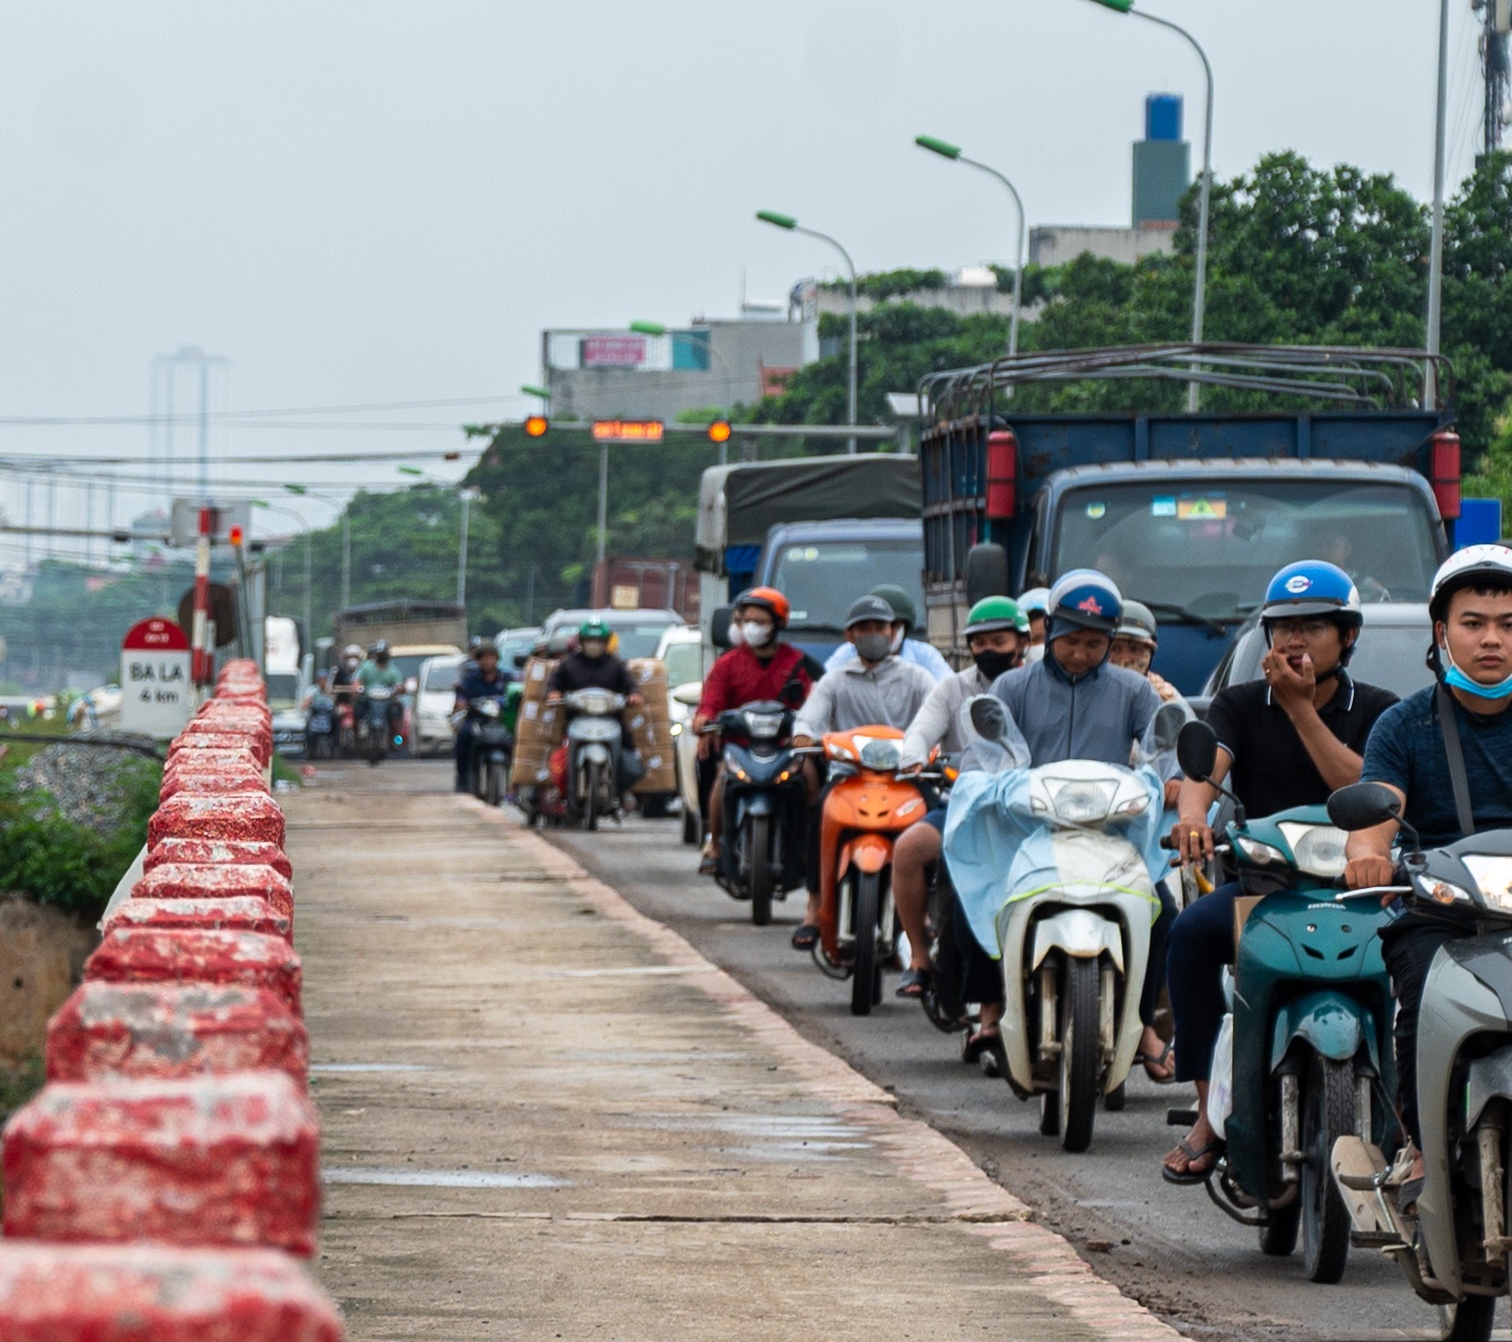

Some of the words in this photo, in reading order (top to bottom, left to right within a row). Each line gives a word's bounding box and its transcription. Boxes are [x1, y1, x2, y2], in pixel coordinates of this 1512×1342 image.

[129, 662, 155, 681] BA
[159, 662, 184, 681] LA
[155, 689, 179, 703] km
[1308, 902, 1347, 910] HONDA
